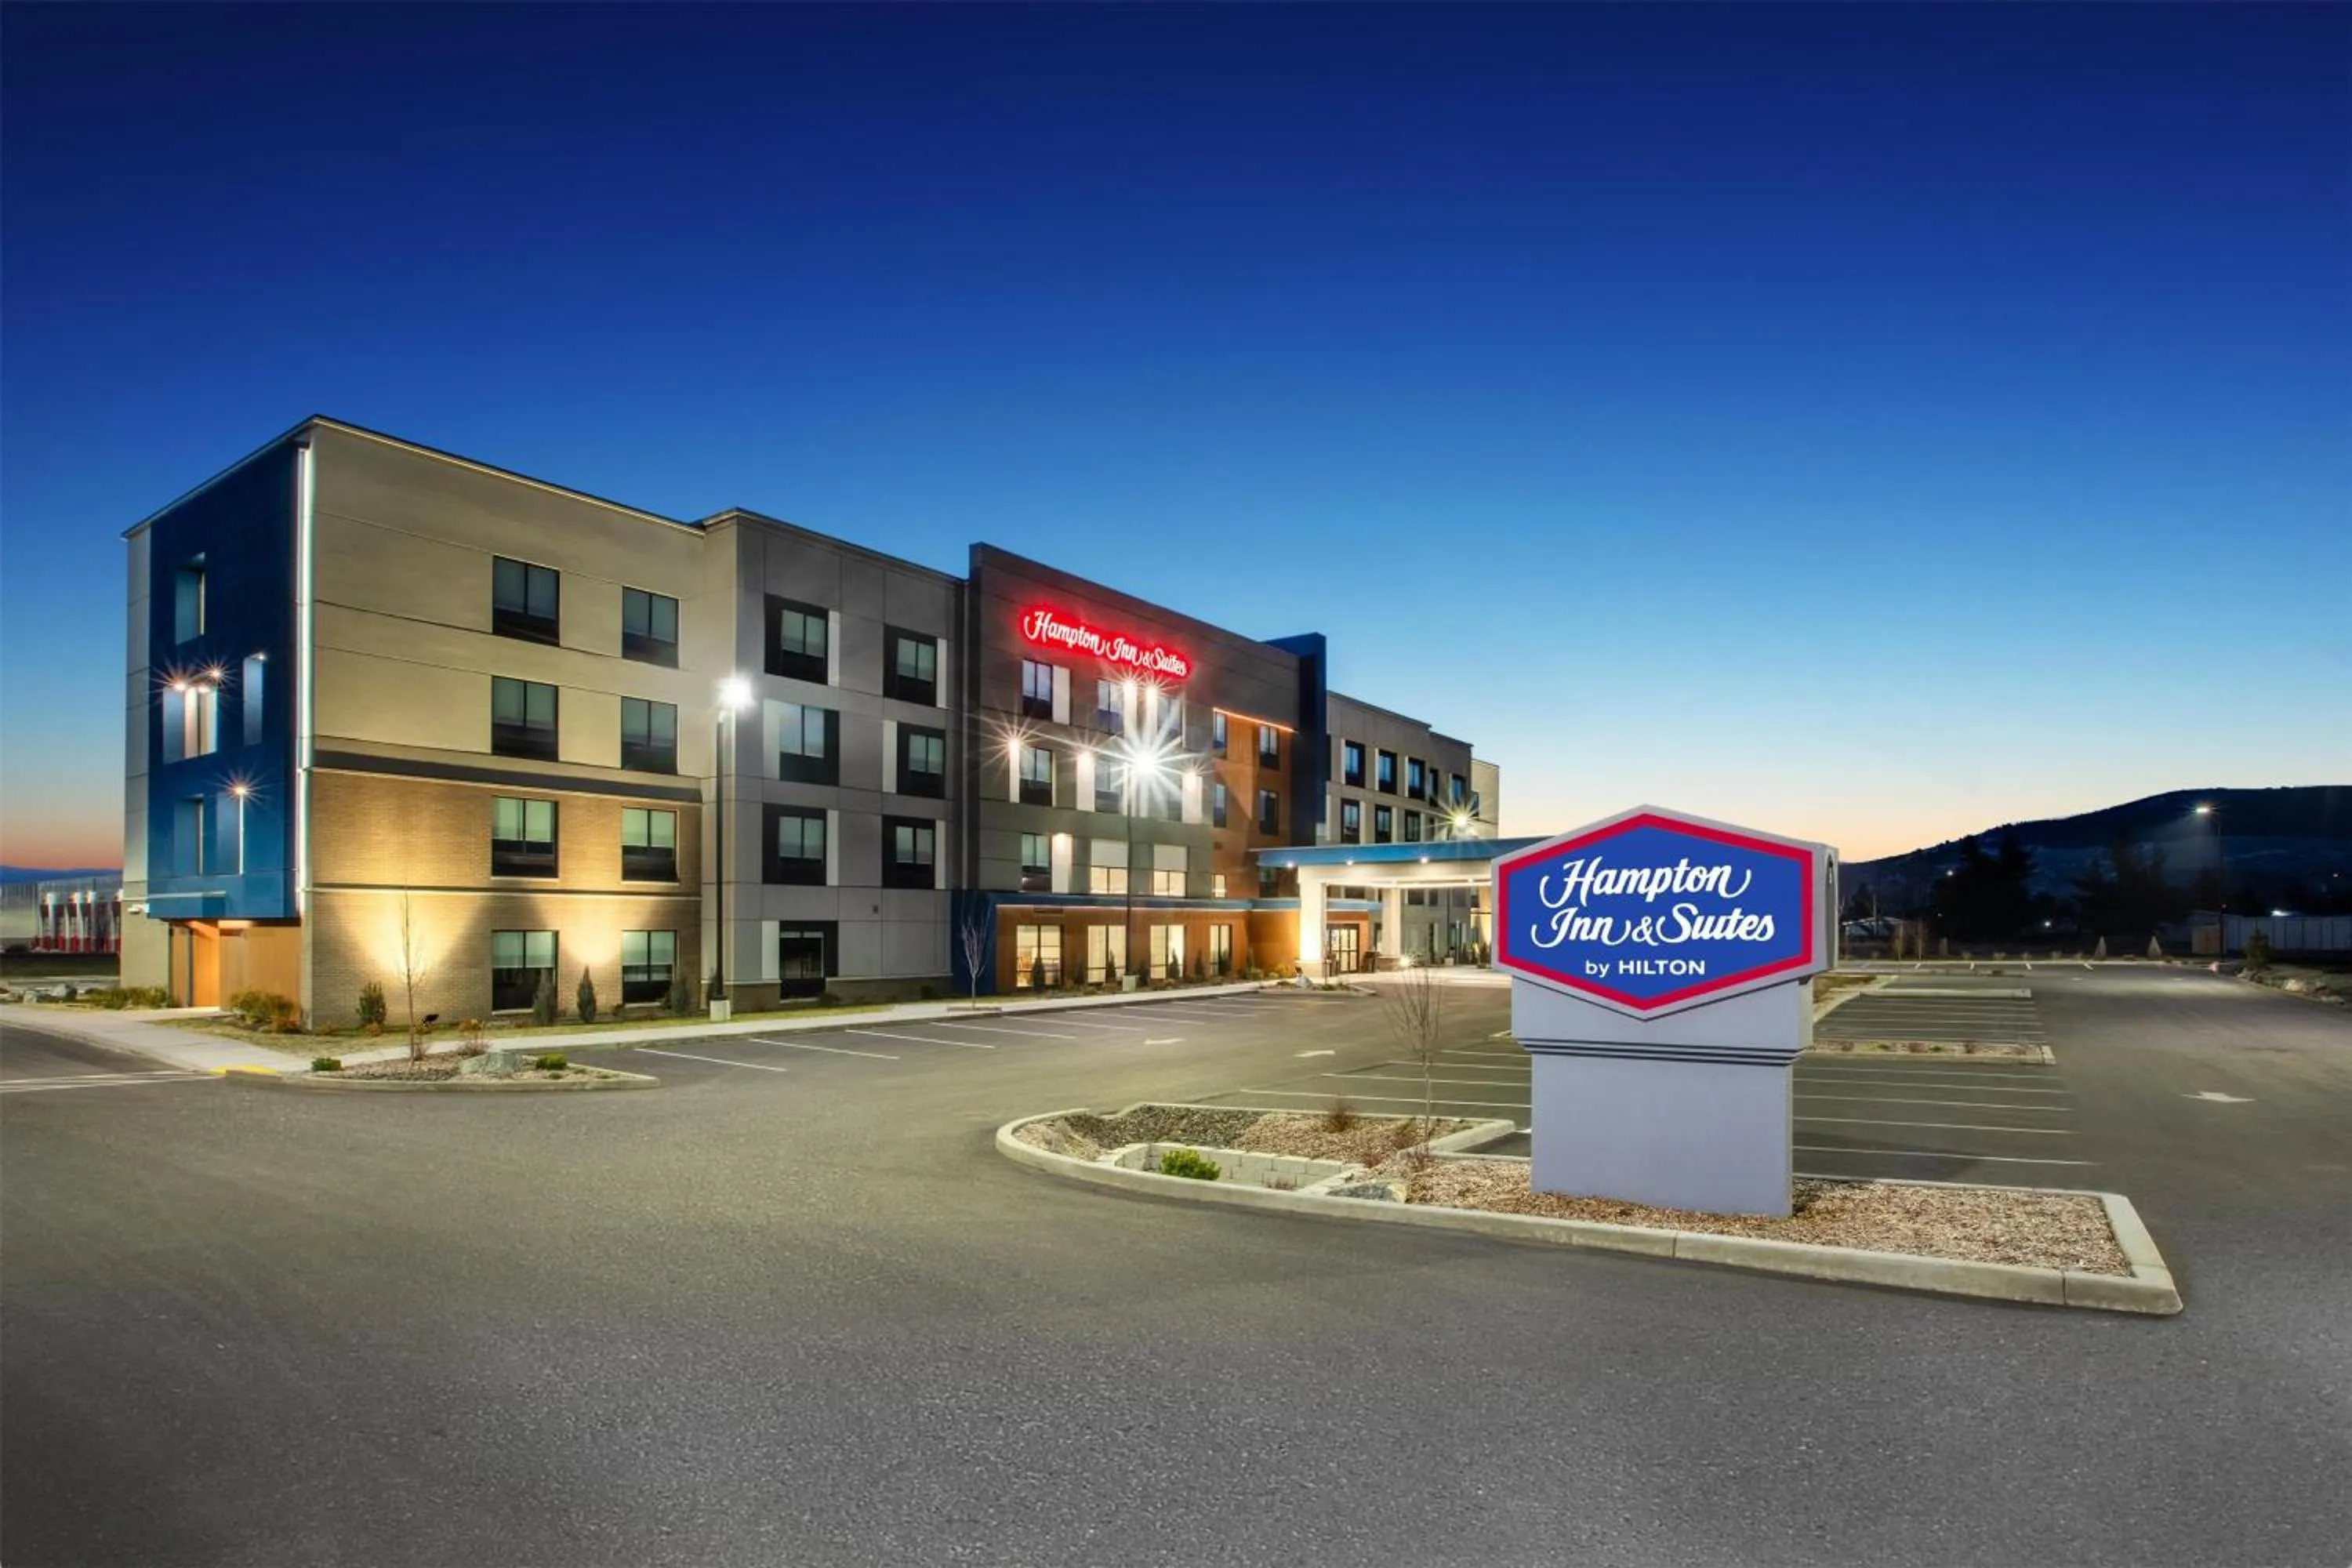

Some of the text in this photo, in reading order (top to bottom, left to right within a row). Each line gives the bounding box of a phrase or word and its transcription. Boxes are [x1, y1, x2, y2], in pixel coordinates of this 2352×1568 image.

[1023, 611, 1106, 655] Hampton
[1106, 637, 1142, 666] Inn
[1149, 648, 1186, 677] Suites
[1539, 855, 1751, 909] Hampton
[1530, 902, 1776, 948] Inn & Suites
[1585, 959, 1705, 978] by HILTON
